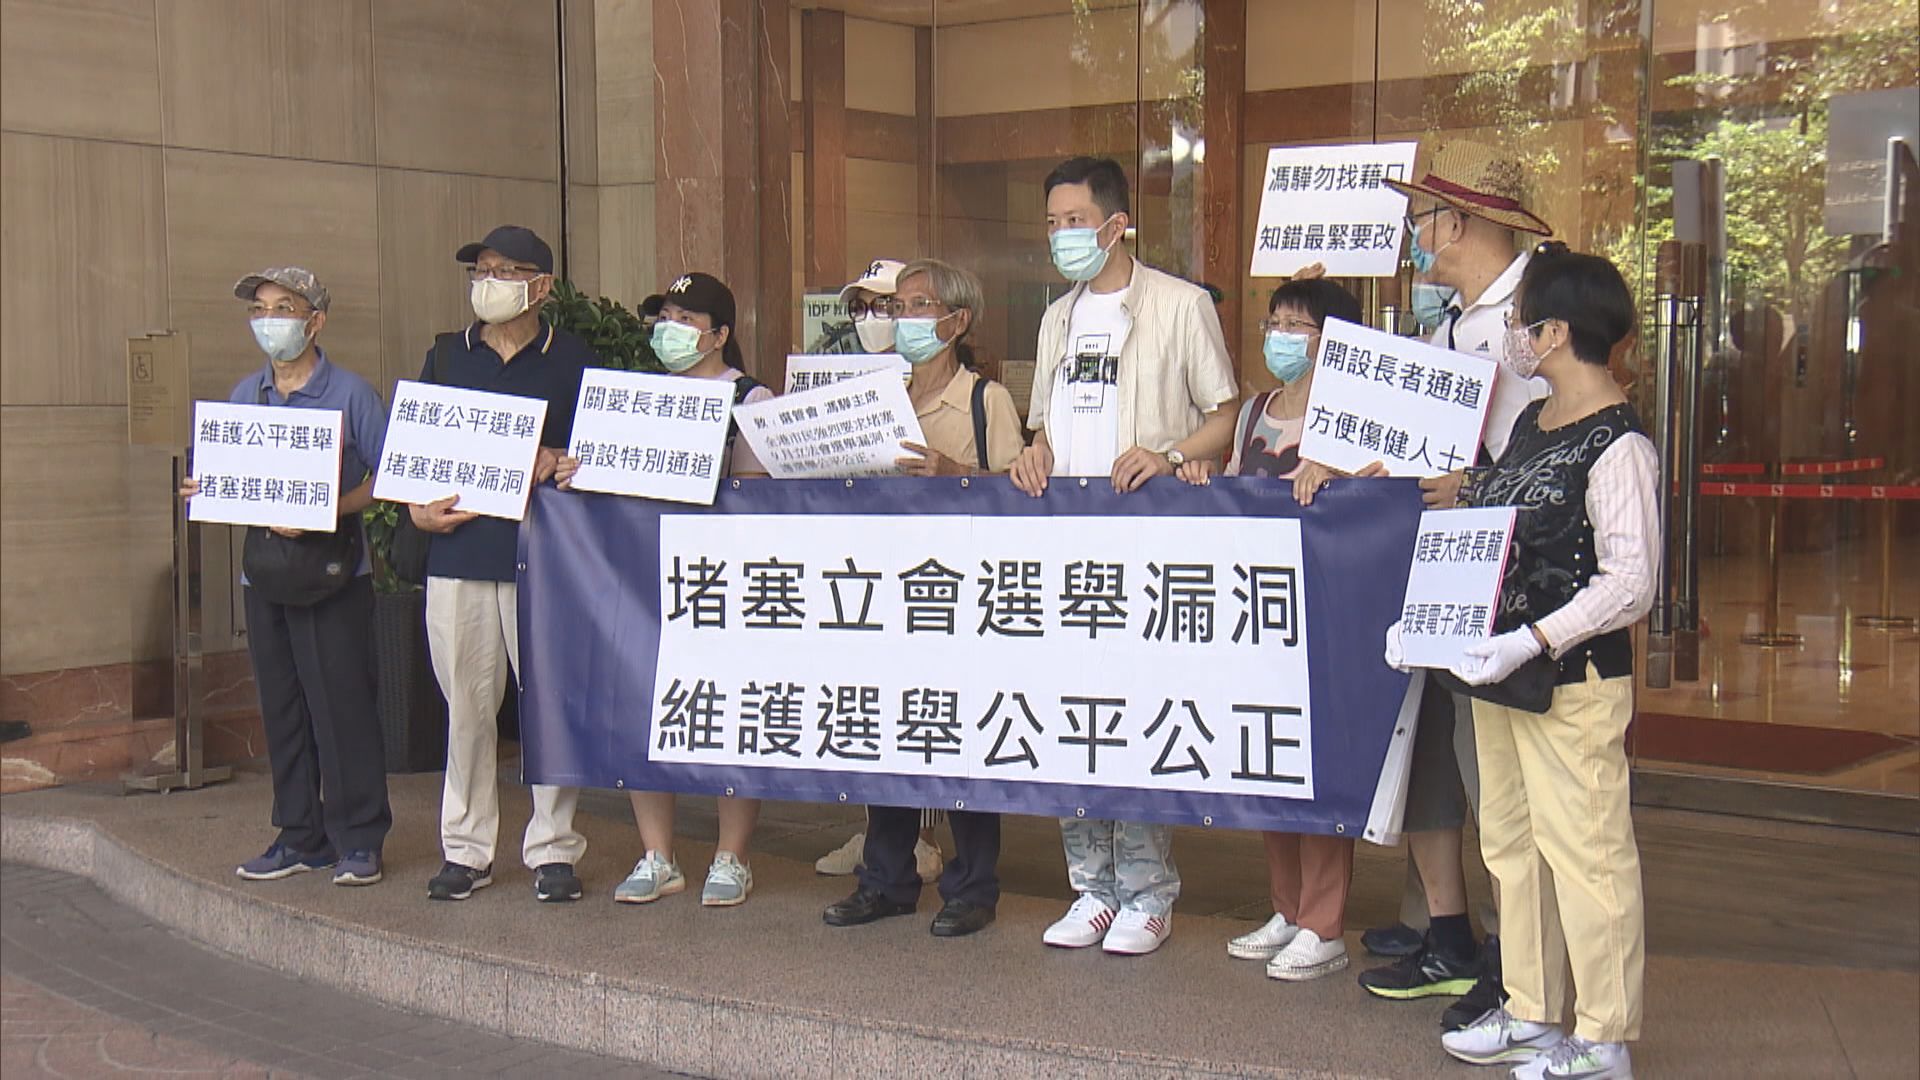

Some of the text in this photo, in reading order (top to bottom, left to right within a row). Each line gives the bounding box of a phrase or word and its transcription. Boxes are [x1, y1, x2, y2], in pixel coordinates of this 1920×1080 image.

[1259, 223, 1397, 251] 知錯最緊要改
[808, 303, 830, 317] IDP
[1322, 340, 1483, 410] 開設長者通道
[396, 398, 536, 439] 維護公平選舉
[583, 386, 724, 423] 關愛長者選民
[200, 418, 333, 451] 維護公平選舉
[1308, 405, 1465, 473] 方便傷健人士
[384, 451, 525, 495] 堵塞選舉漏洞
[575, 440, 714, 479] 增設特別通道
[198, 473, 330, 507] 堵塞選舉漏洞
[1416, 530, 1504, 563] 唔要大排長龍
[667, 555, 1299, 647] 堵塞立會選舉漏洞
[1402, 604, 1489, 637] 我要電子派票
[657, 678, 1306, 785] 維護選舉公平公正
